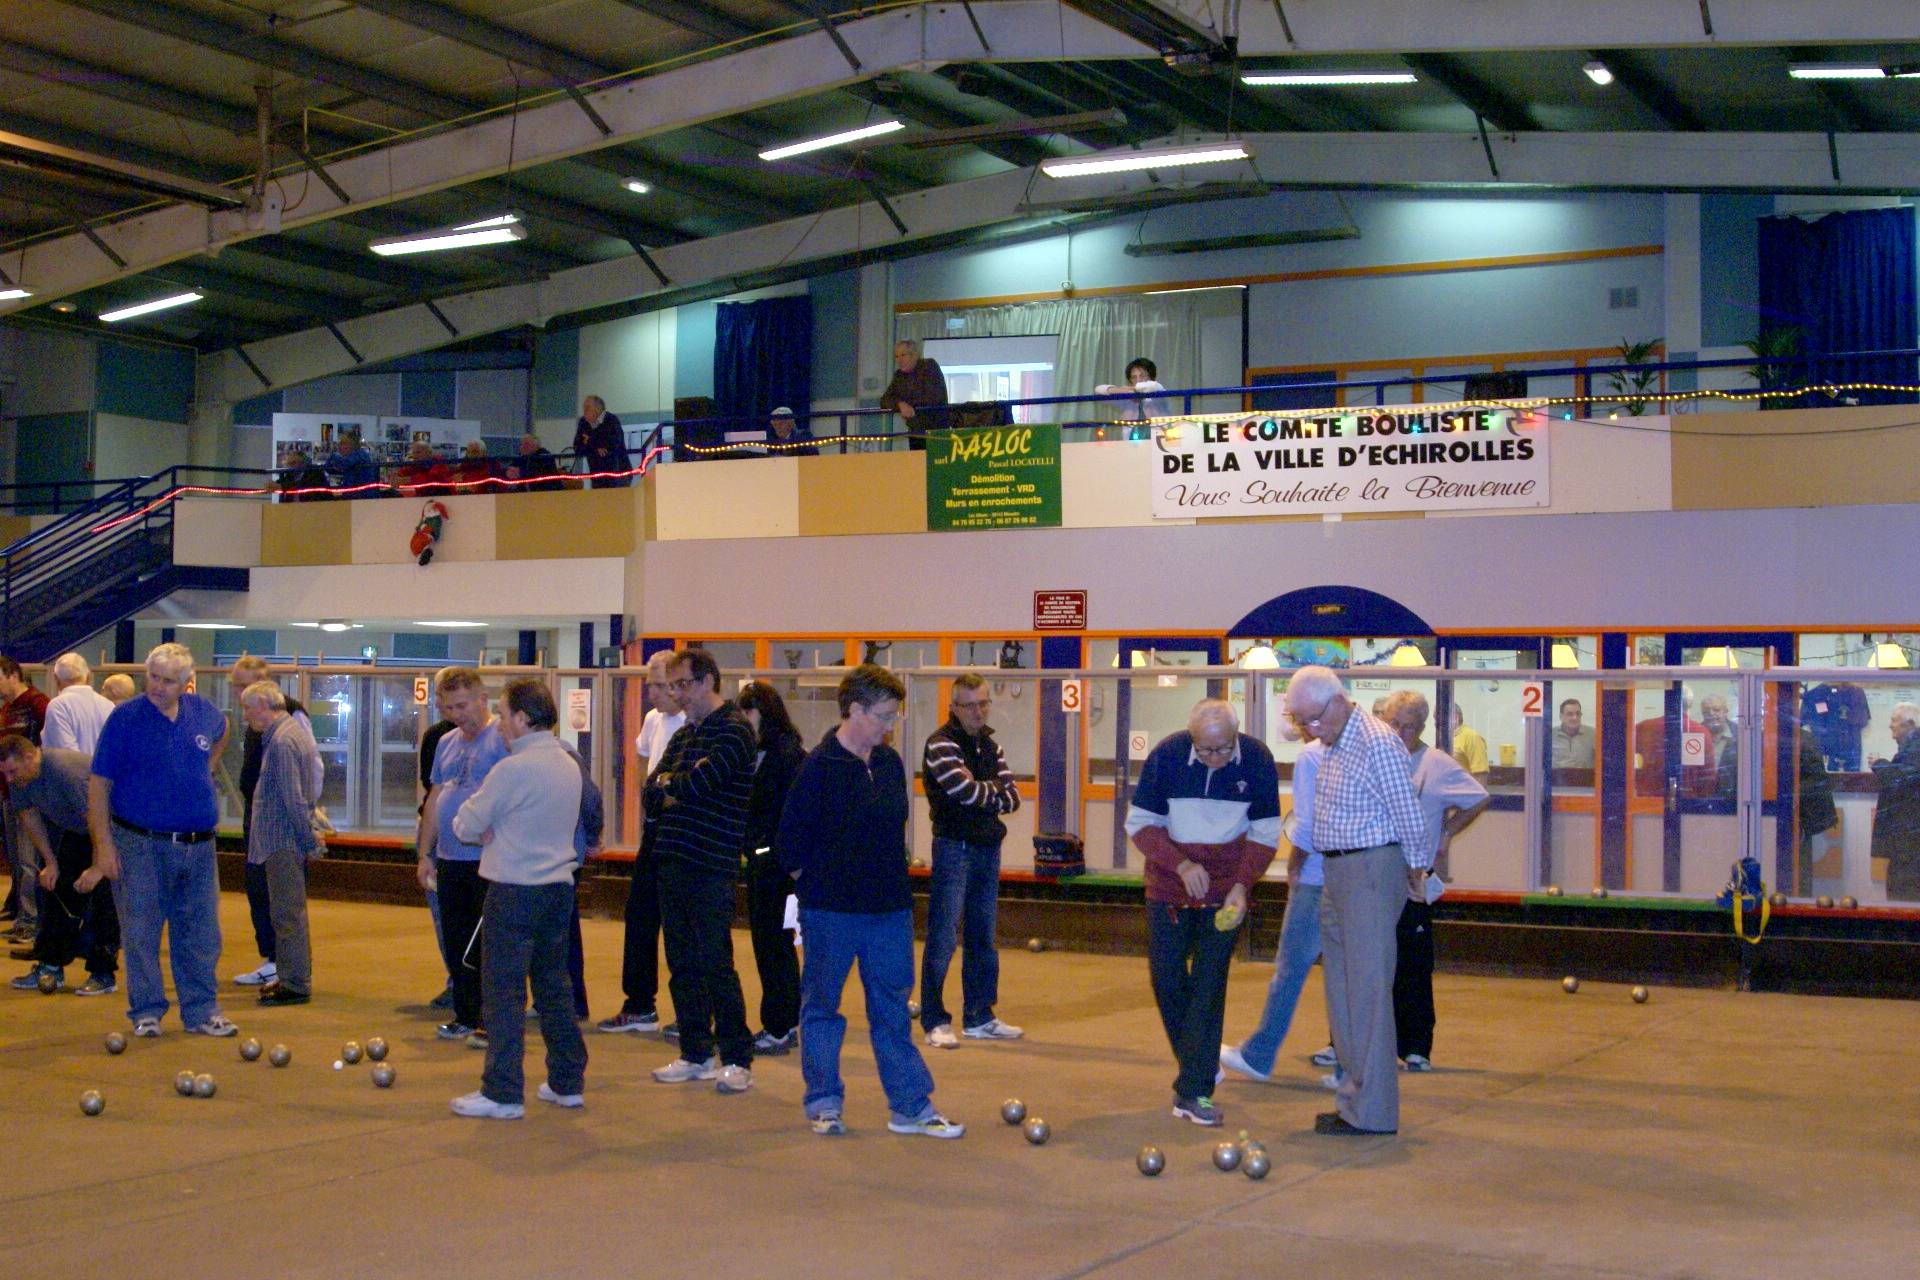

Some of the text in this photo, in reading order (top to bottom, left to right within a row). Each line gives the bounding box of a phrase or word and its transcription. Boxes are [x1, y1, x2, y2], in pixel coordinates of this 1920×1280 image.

[1203, 410, 1490, 443] LE COMITE BOULISTE
[950, 428, 1032, 463] PASLOC
[1163, 438, 1535, 474] DE LA VILLE D'ECHIROLLES
[1010, 457, 1054, 467] LOCATELLI
[952, 485, 1009, 496] Terrassement
[1016, 484, 1035, 493] VRD
[971, 474, 1015, 483] Démolition
[1164, 475, 1536, 507] Vous Souhaite la Bienvenue
[945, 499, 967, 508] Murs
[981, 496, 1042, 507] enrochements
[415, 681, 427, 701] 5
[1063, 684, 1079, 709] 3
[1522, 687, 1541, 713] 2
